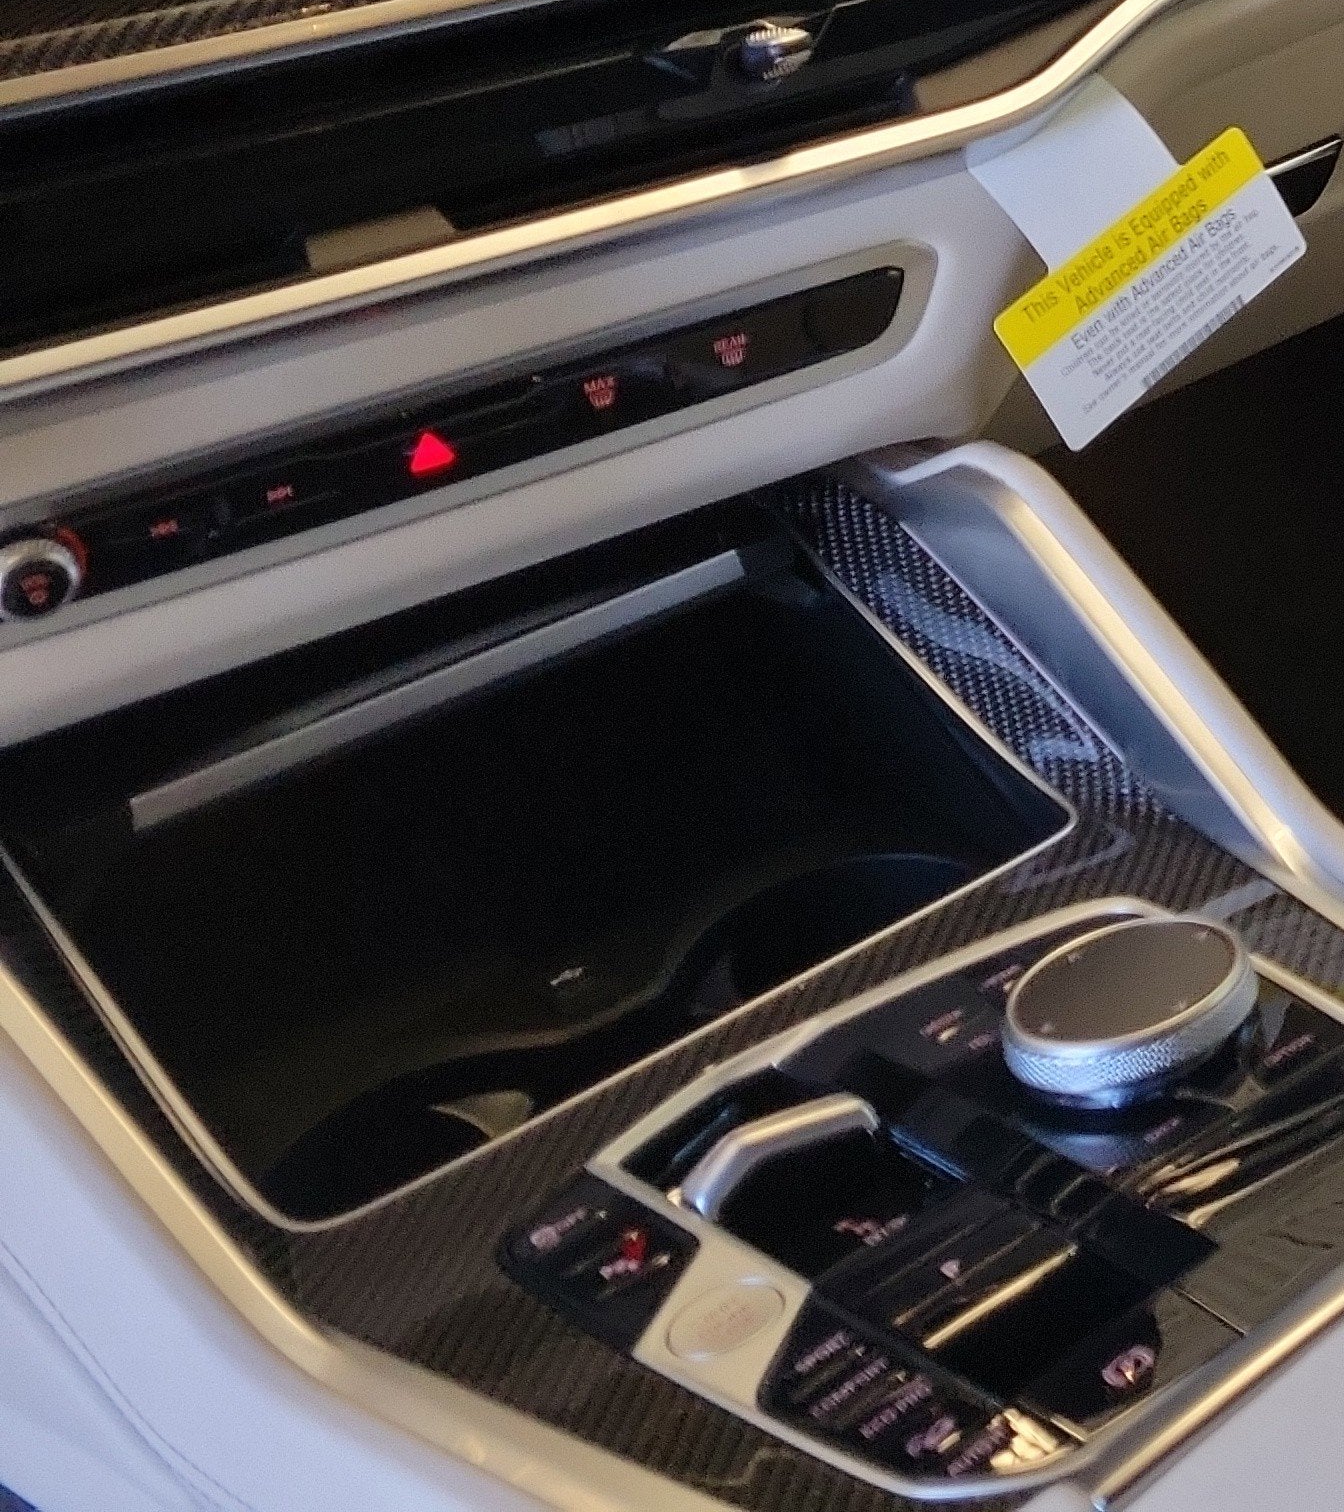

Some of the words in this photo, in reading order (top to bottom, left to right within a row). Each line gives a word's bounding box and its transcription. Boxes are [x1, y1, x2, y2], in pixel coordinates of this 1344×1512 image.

[1021, 288, 1060, 324] This
[1053, 242, 1117, 295] Vehicle
[1124, 172, 1203, 238] Equipped
[1197, 148, 1231, 183] with
[1068, 316, 1107, 350] Even
[1100, 293, 1133, 323] with
[1126, 247, 1192, 301] Advanced
[1184, 230, 1208, 253] Air
[1202, 206, 1239, 239] Bags
[1069, 247, 1151, 314] Advanced
[1144, 228, 1172, 254] Air
[1166, 196, 1211, 235] Bags
